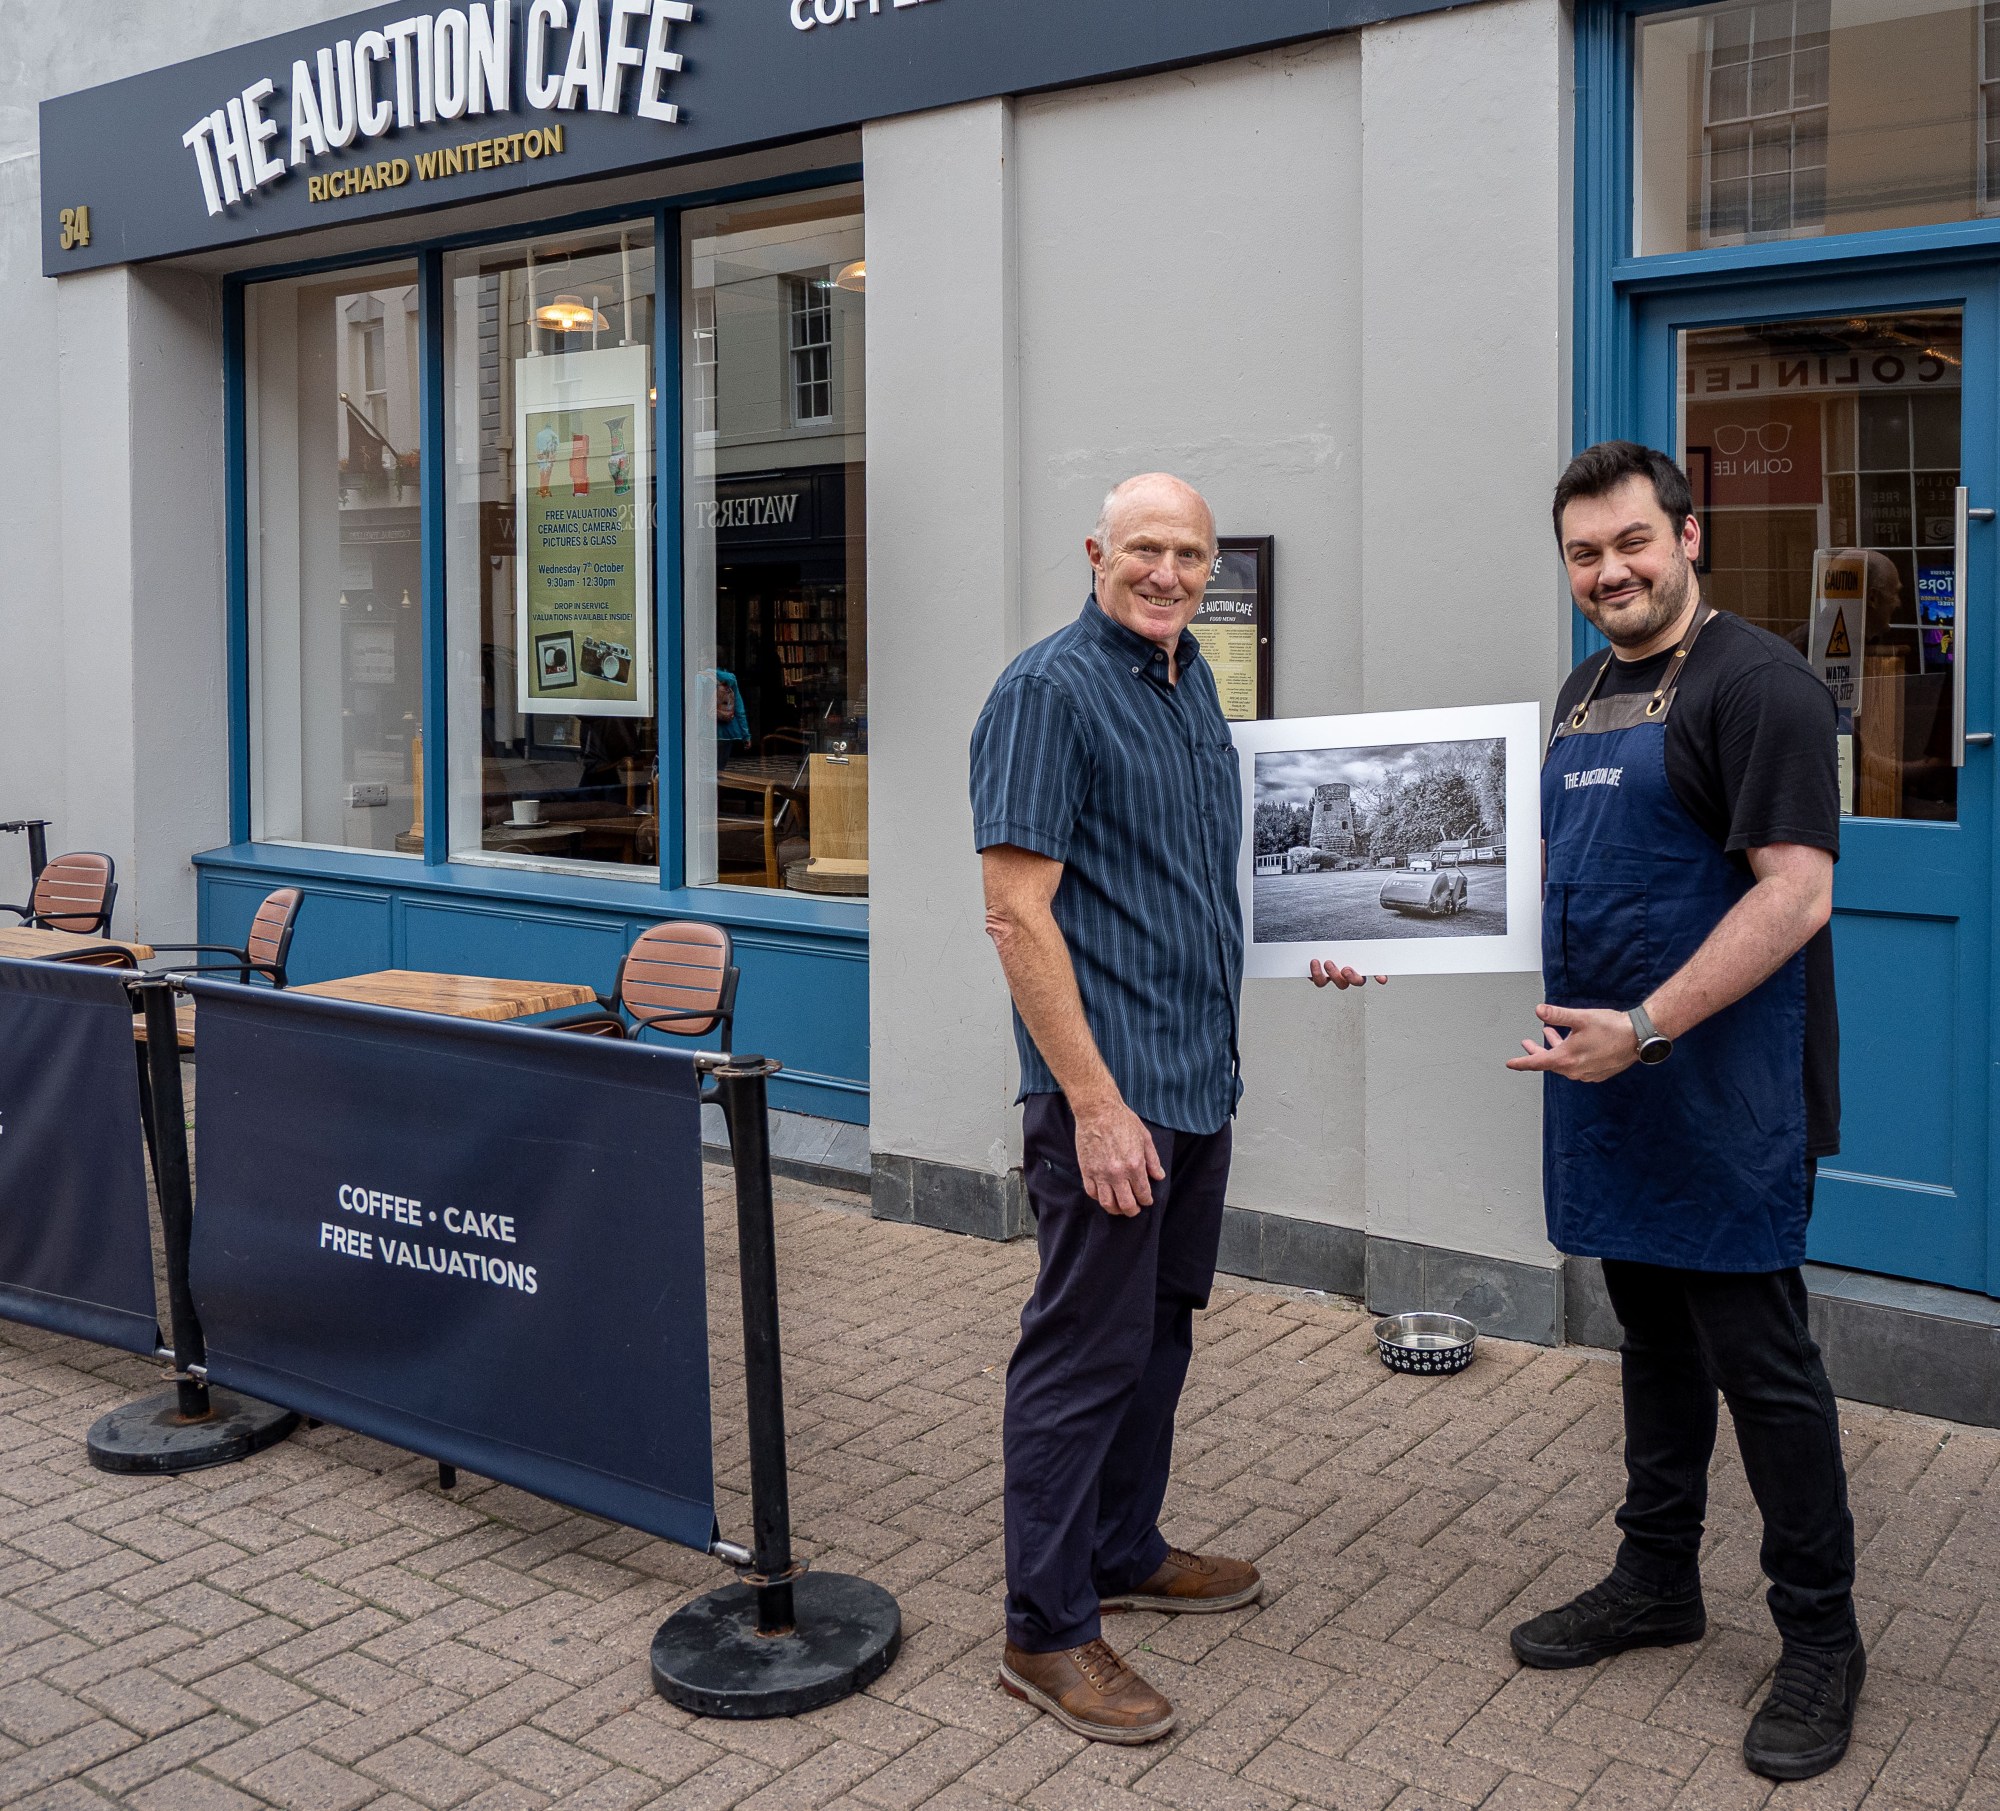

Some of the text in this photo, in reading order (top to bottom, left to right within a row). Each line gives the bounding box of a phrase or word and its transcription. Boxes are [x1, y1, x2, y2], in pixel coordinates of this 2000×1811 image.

[182, 77, 286, 217] THE
[290, 0, 511, 167] AUCTION
[308, 124, 563, 203] RICHARD WINTERTON
[60, 205, 90, 250] 34
[545, 507, 618, 520] FREE VALUATIONS
[538, 521, 624, 534] CERAMICS, CAMERAS,
[542, 535, 617, 547] PICTURES & GLASS
[538, 562, 624, 576] Wednesday 7th October
[546, 577, 575, 588] 9:30am
[582, 576, 616, 589] 12:30pm
[1824, 570, 1859, 591] CAUTION
[554, 602, 573, 610] DROP
[581, 602, 610, 610] SERVICE
[1206, 600, 1235, 613] AUCTION
[1235, 602, 1253, 617] CAFÉ
[532, 613, 633, 621] VALUATIONS AVAILABLE INSIDE!
[1825, 665, 1850, 684] WATCH
[1839, 683, 1855, 701] STEP
[1563, 771, 1581, 790] THE
[1579, 768, 1609, 787] AUCTION
[338, 1183, 517, 1243] COFFEE CAKE
[320, 1221, 538, 1295] FREE VALUATIONS
